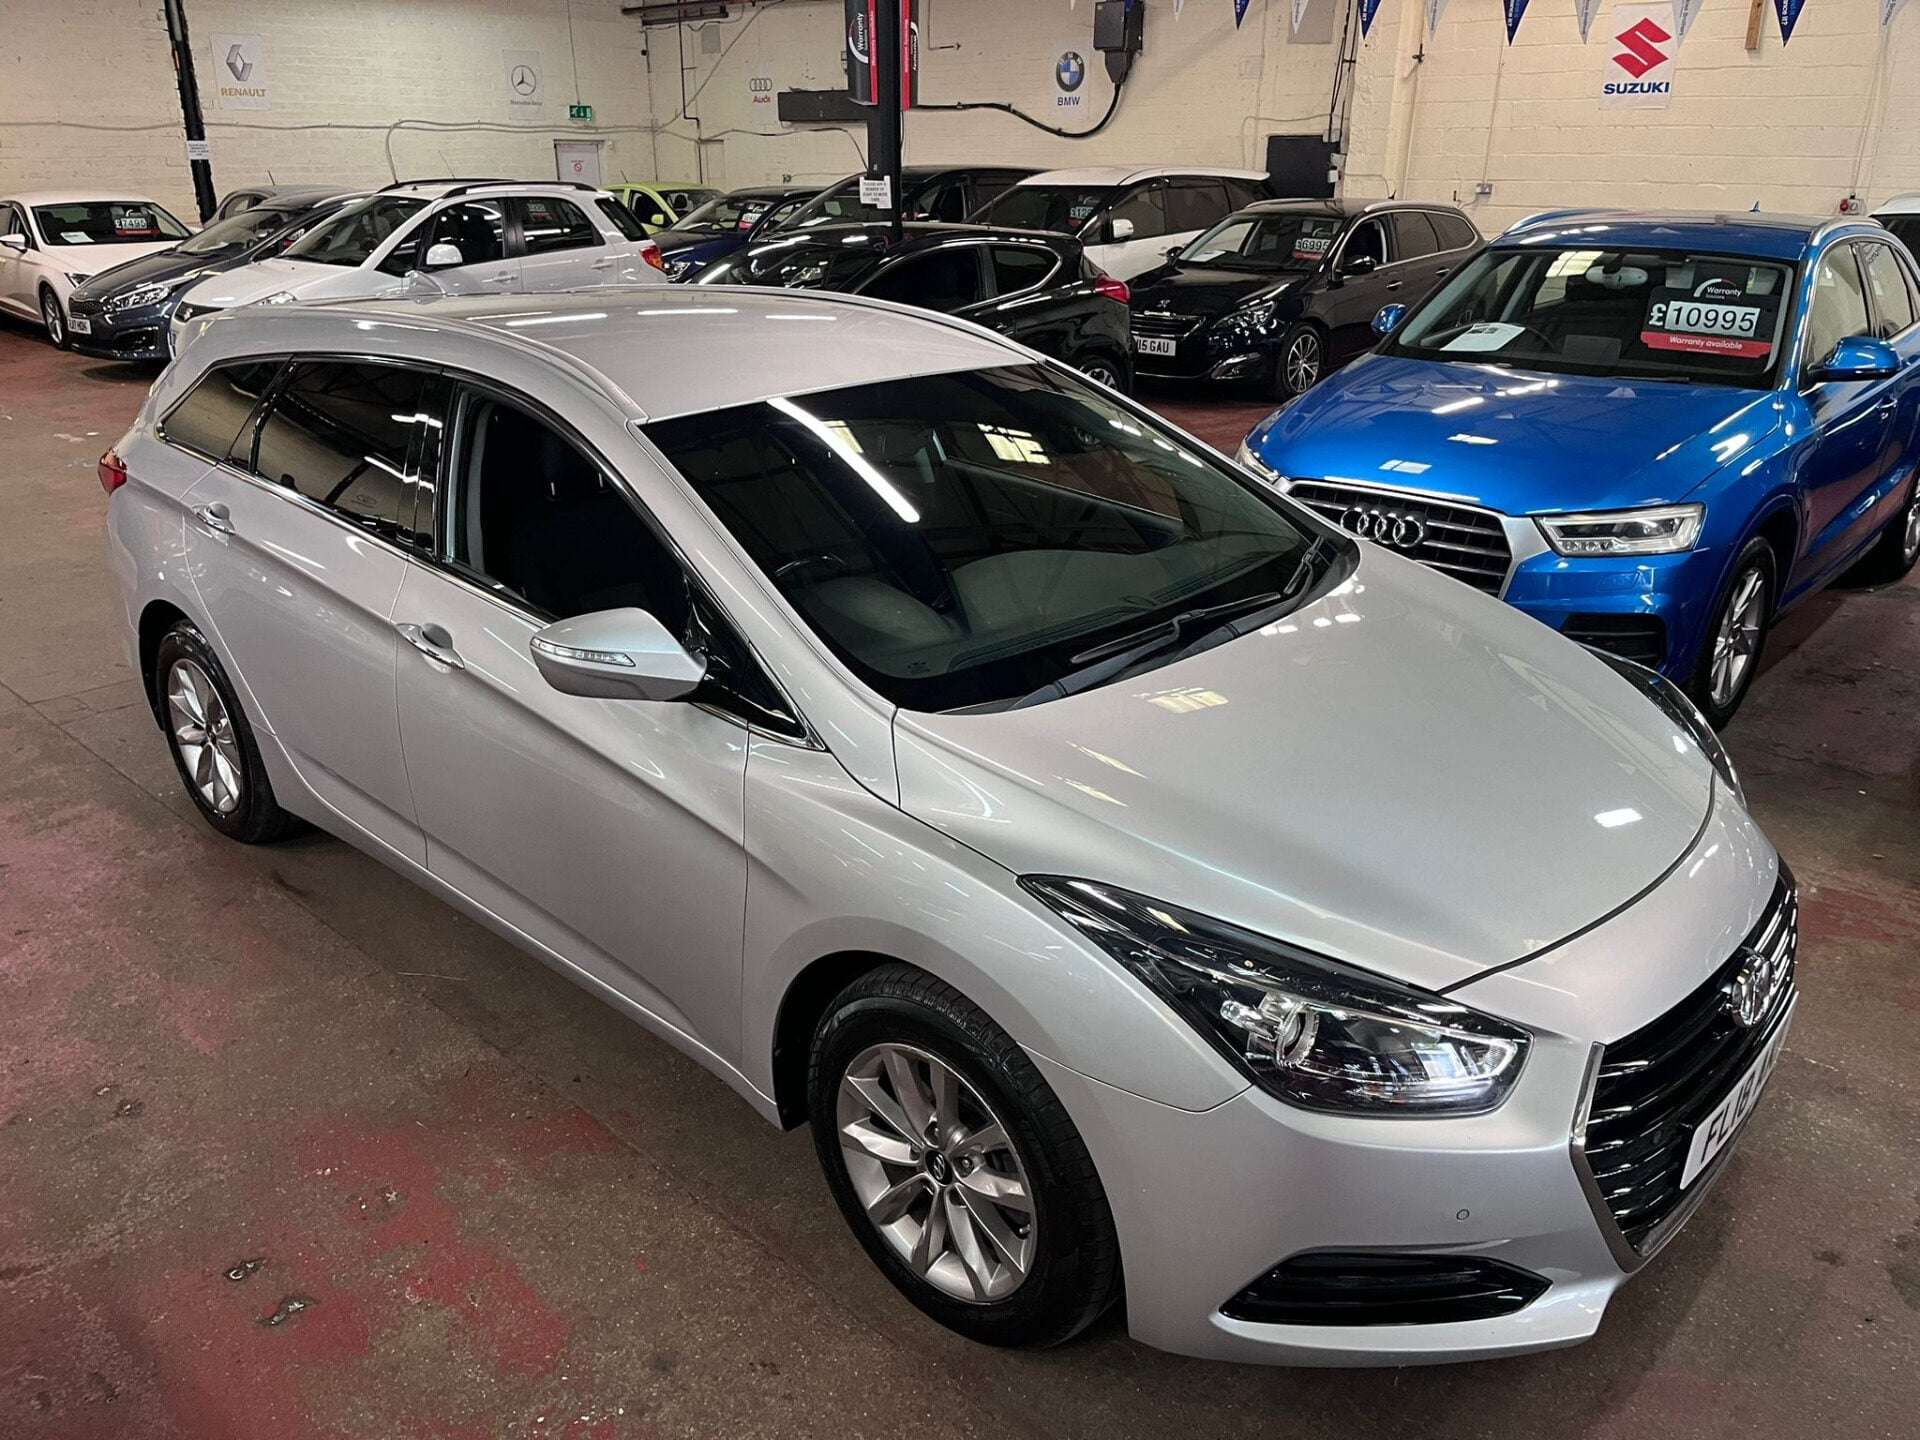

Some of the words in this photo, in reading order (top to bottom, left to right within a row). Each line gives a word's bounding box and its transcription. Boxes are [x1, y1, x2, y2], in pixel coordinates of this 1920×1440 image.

[857, 12, 865, 51] Warranty
[220, 87, 267, 97] RENAULT
[1603, 82, 1670, 95] SUZUKI
[752, 94, 772, 104] Audi
[1057, 96, 1081, 106] BMW
[1706, 285, 1743, 298] Warranty
[1649, 302, 1756, 333] £10995
[1150, 340, 1169, 353] GAU
[1669, 335, 1705, 347] Warranty
[1706, 340, 1743, 351] available
